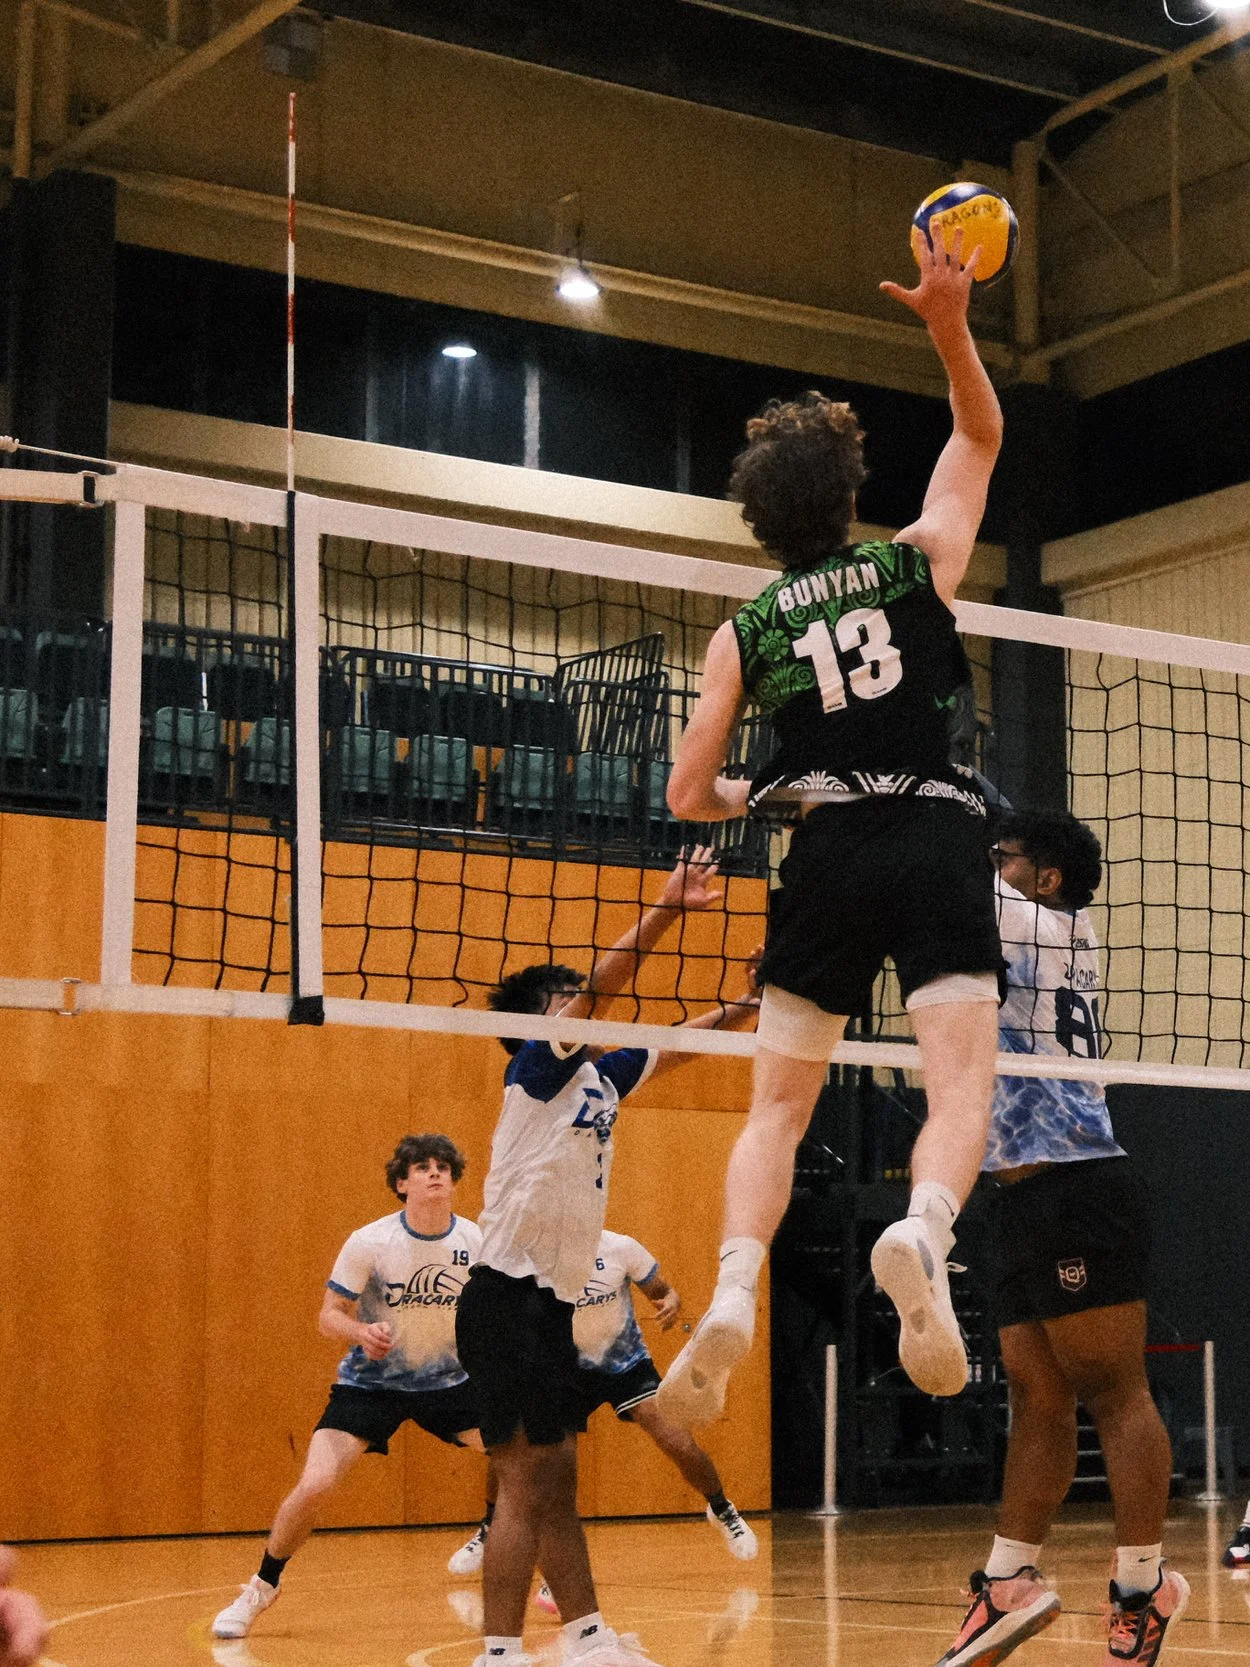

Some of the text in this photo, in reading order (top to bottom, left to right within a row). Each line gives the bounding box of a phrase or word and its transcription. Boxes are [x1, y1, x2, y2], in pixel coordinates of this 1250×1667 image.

[777, 562, 880, 613] BUNYAN
[792, 608, 903, 714] 13
[452, 1249, 469, 1266] 19
[576, 1291, 617, 1308] CARYS
